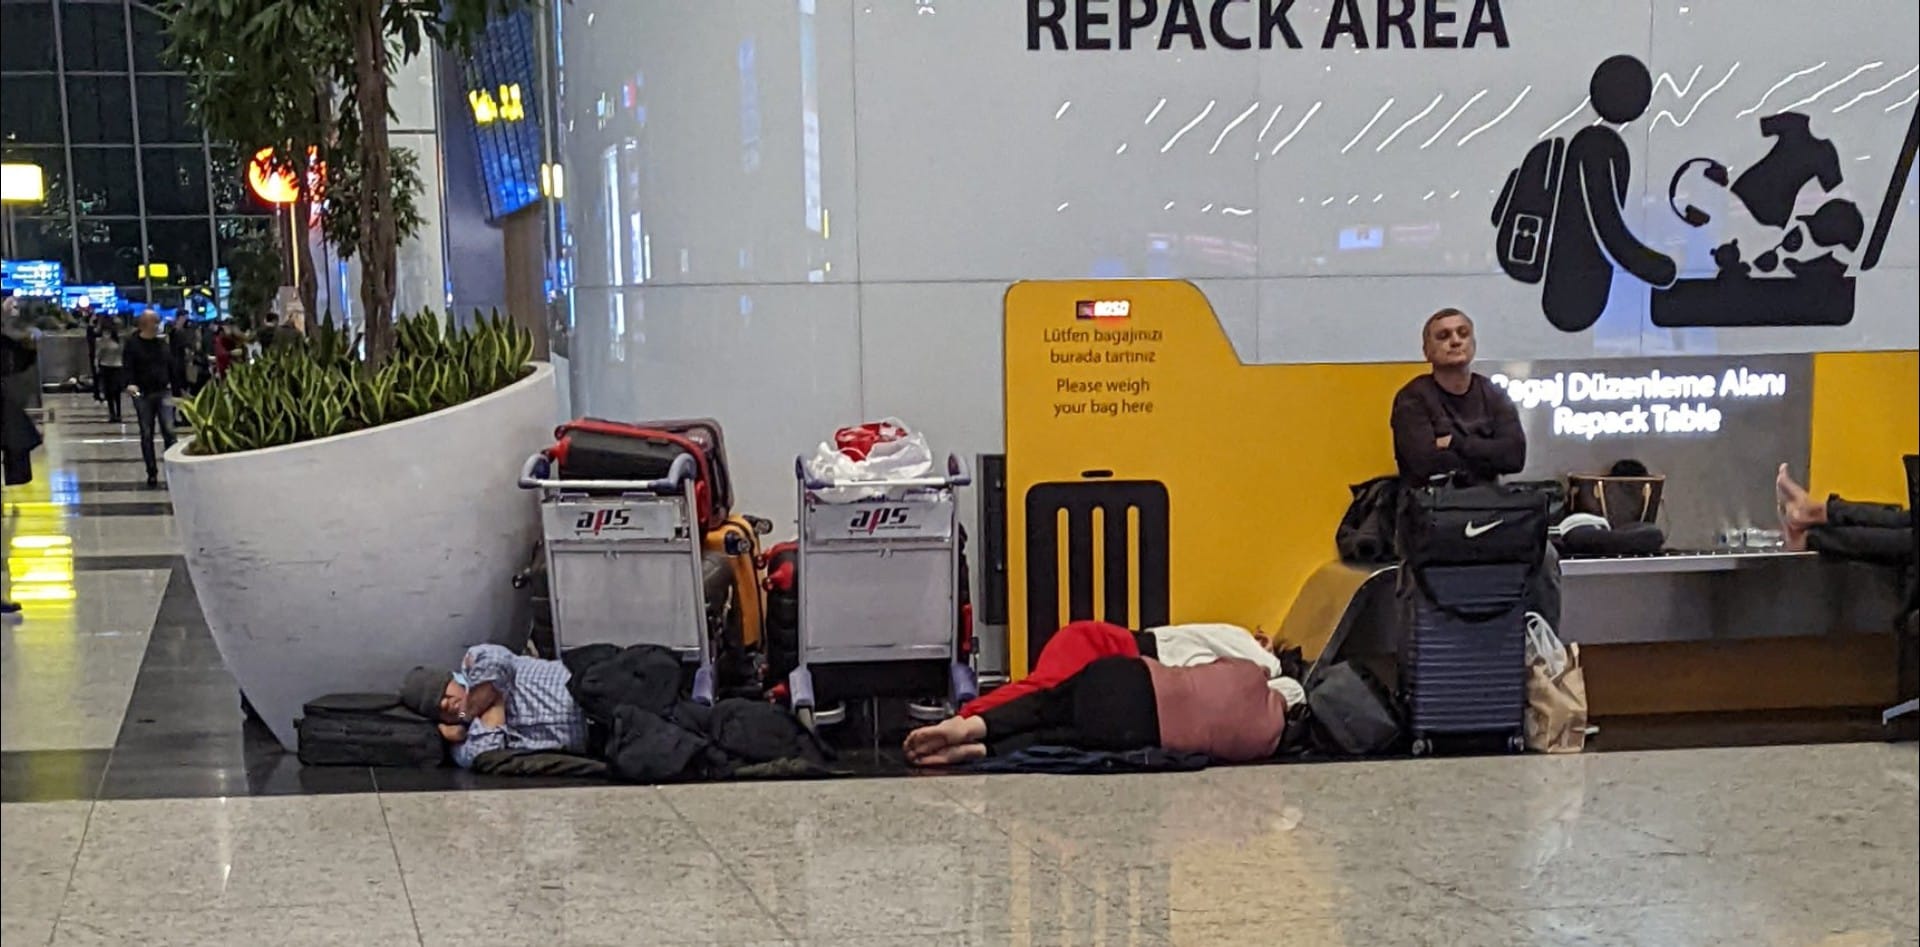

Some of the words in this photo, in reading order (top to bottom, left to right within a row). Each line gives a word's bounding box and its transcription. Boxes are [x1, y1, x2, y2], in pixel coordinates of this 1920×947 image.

[1026, 0, 1303, 51] REPACK
[1321, 0, 1511, 49] AREA
[1043, 327, 1089, 343] Lütfen
[1050, 349, 1101, 363] burada
[1056, 378, 1103, 392] Please
[1106, 378, 1150, 395] weigh
[1491, 373, 1563, 408] agaj
[1568, 370, 1716, 400] Düzenleme
[1053, 402, 1086, 418] your
[1090, 399, 1118, 416] bag
[1121, 399, 1153, 413] here
[1553, 405, 1650, 440] Repack
[1650, 403, 1722, 433] Table
[576, 509, 632, 536] aps
[850, 507, 910, 536] aps
